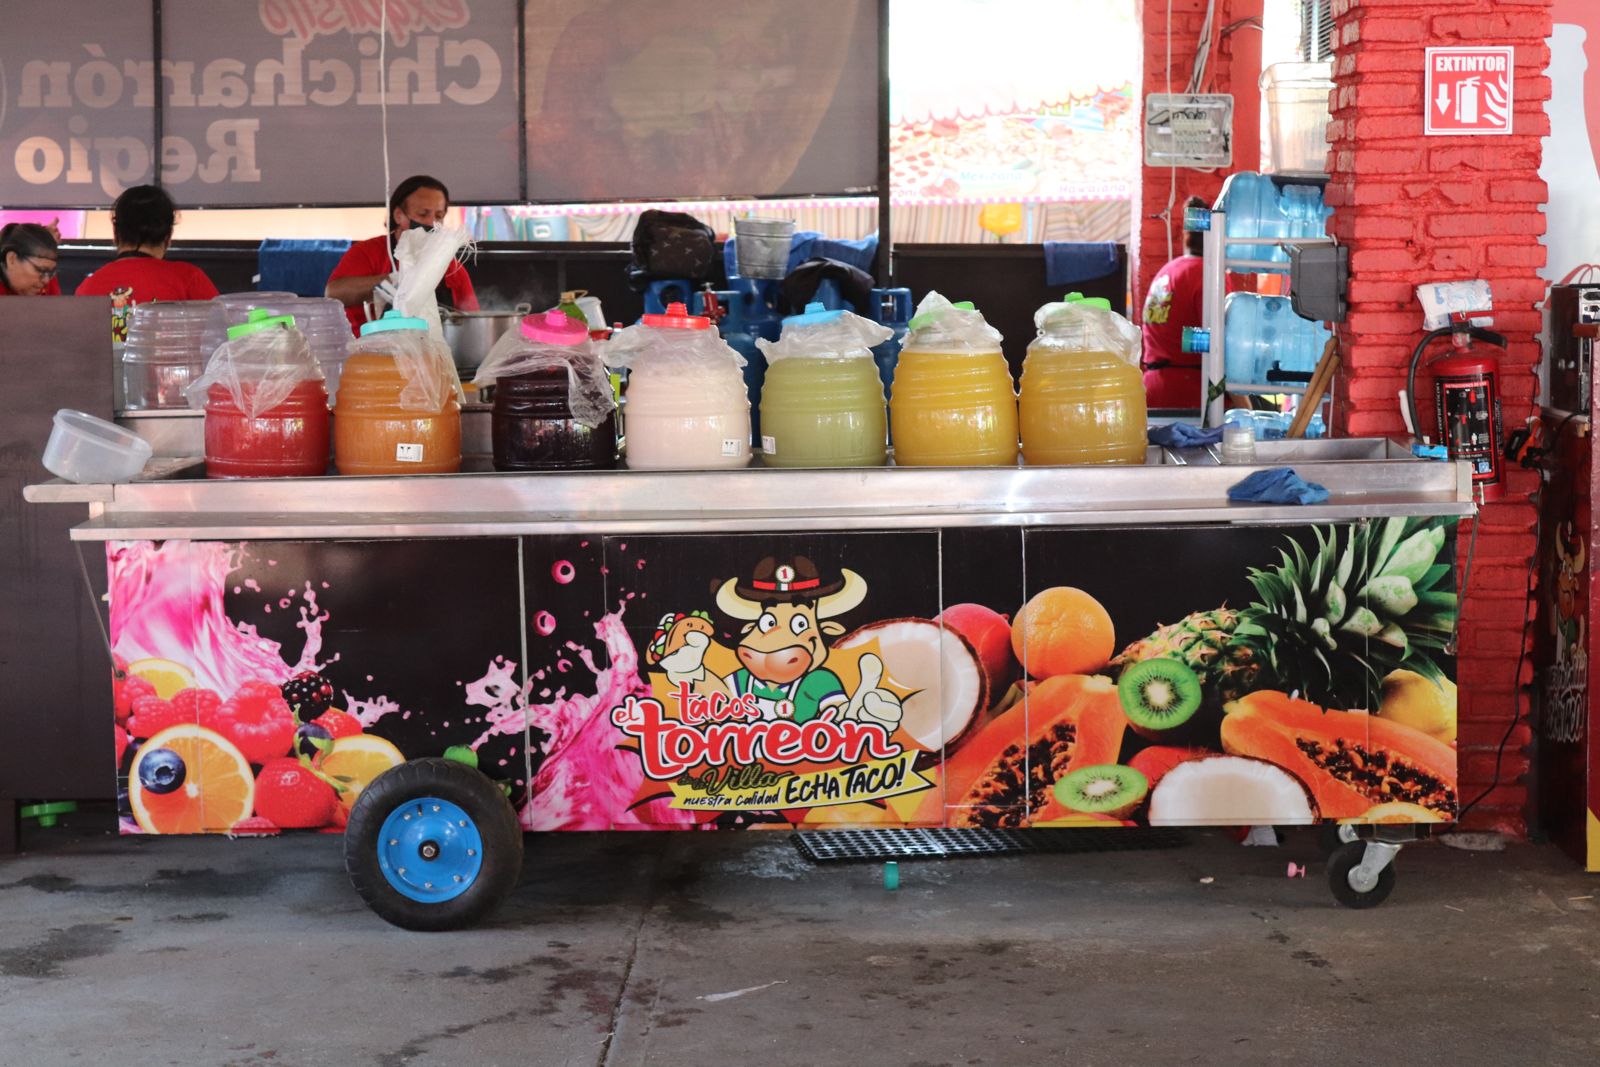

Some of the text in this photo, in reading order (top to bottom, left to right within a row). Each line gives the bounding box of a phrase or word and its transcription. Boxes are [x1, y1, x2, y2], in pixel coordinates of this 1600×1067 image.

[1435, 56, 1506, 72] EXTINTOR
[668, 680, 761, 725] tacos
[615, 699, 899, 776] el torreón
[701, 764, 794, 795] Villa
[839, 758, 906, 797] TACO!
